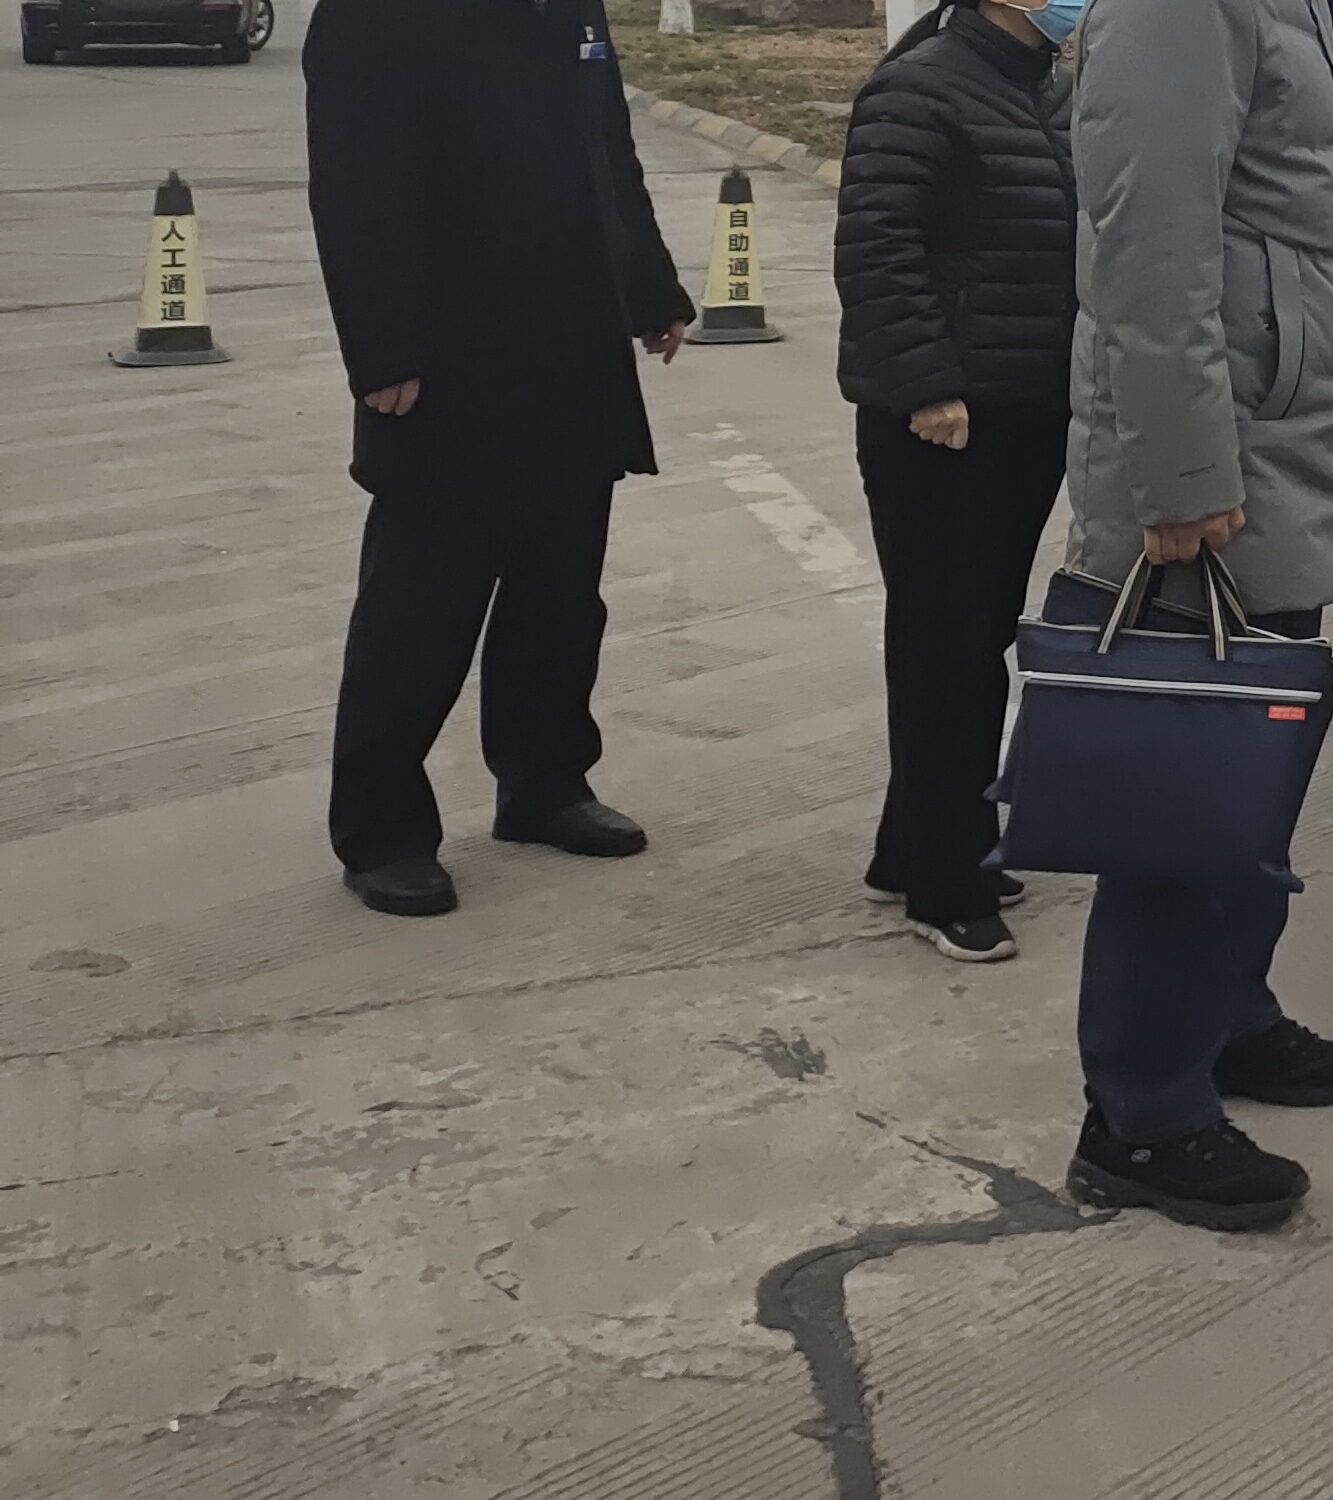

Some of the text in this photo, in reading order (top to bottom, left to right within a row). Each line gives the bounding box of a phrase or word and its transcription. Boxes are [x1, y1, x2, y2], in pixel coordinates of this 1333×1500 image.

[161, 220, 186, 321] 人工通道
[727, 208, 751, 301] 自助通道
